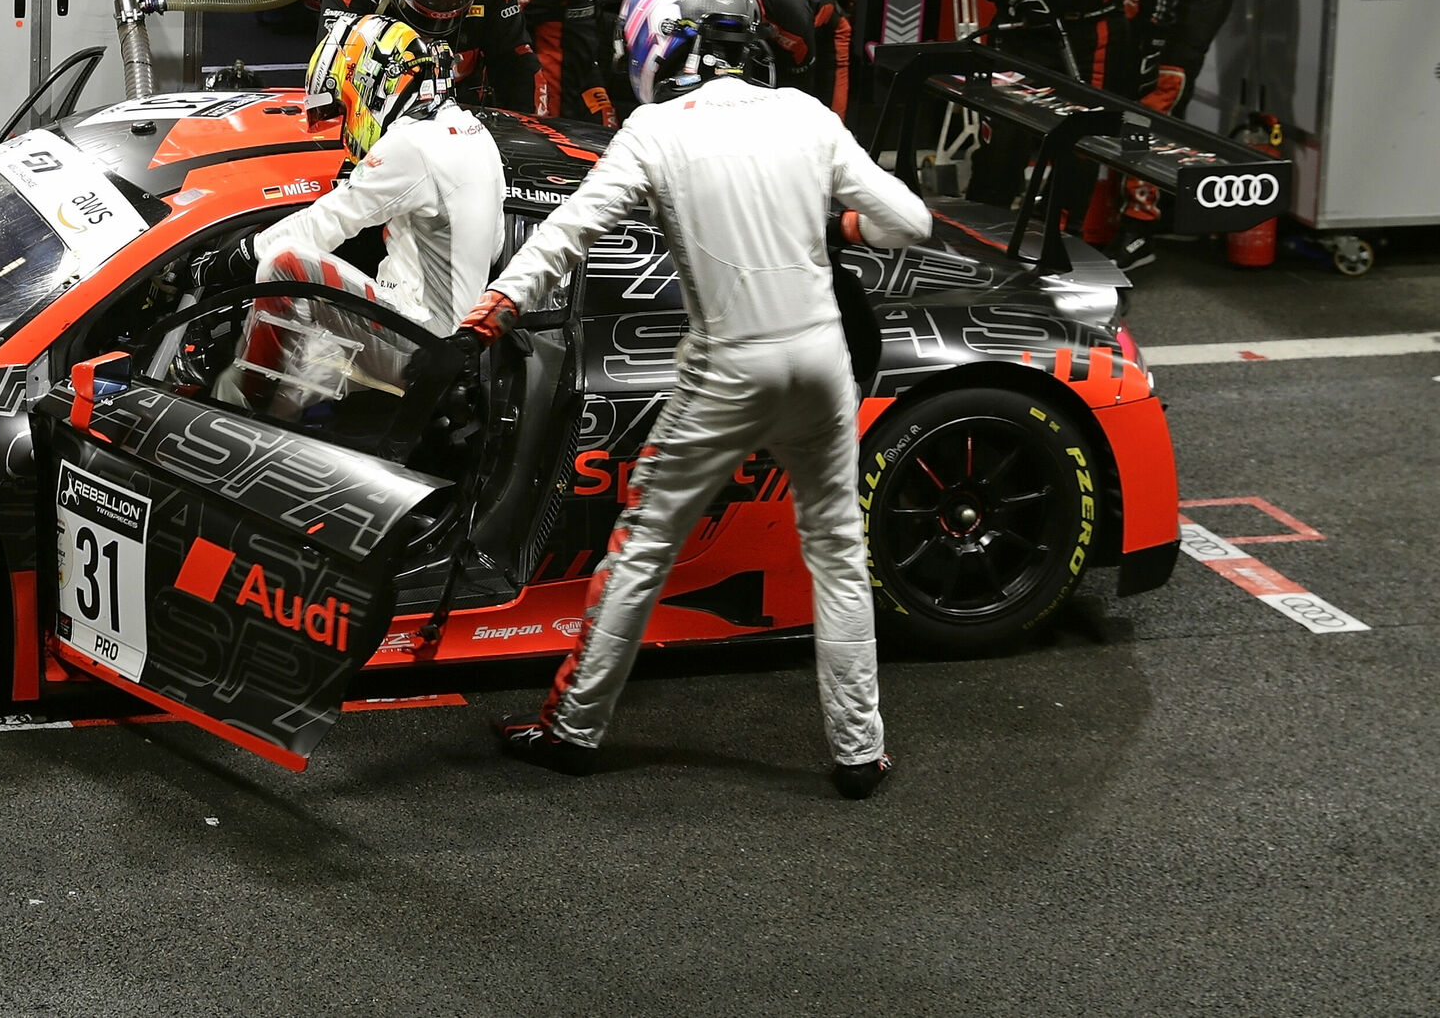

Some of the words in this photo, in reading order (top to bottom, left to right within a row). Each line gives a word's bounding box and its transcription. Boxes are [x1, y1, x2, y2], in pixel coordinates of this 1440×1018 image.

[503, 186, 522, 198] ER
[71, 191, 113, 225] aws
[76, 526, 121, 633] 31
[235, 562, 352, 653] Audi
[94, 634, 119, 661] PRO
[471, 624, 543, 641] Snap-on
